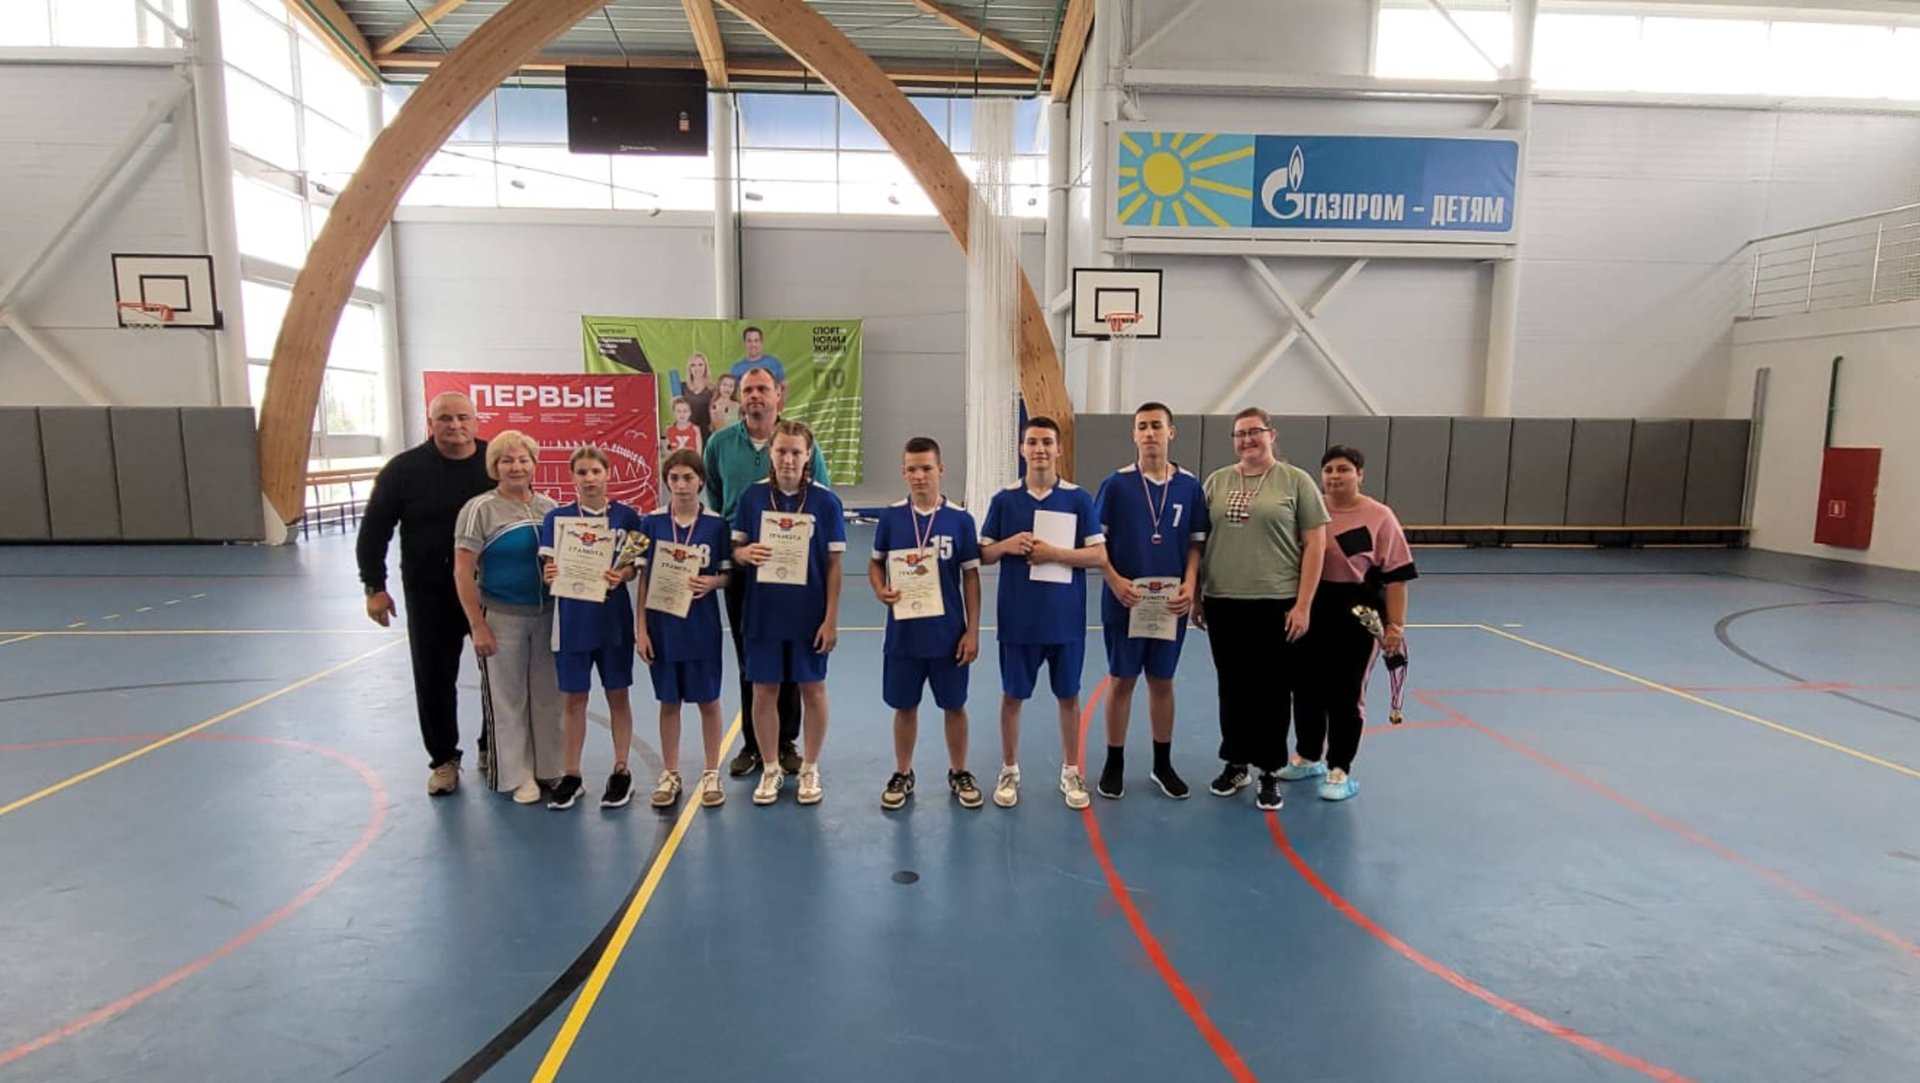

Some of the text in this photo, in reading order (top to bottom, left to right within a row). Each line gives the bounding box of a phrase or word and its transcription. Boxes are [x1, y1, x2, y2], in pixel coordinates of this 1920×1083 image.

[1304, 192, 1405, 221] ГАЗПРОМ
[1431, 195, 1504, 226] ДЕТЯМ
[470, 384, 615, 408] ПЕРВЫЕ
[1172, 504, 1183, 527] 7
